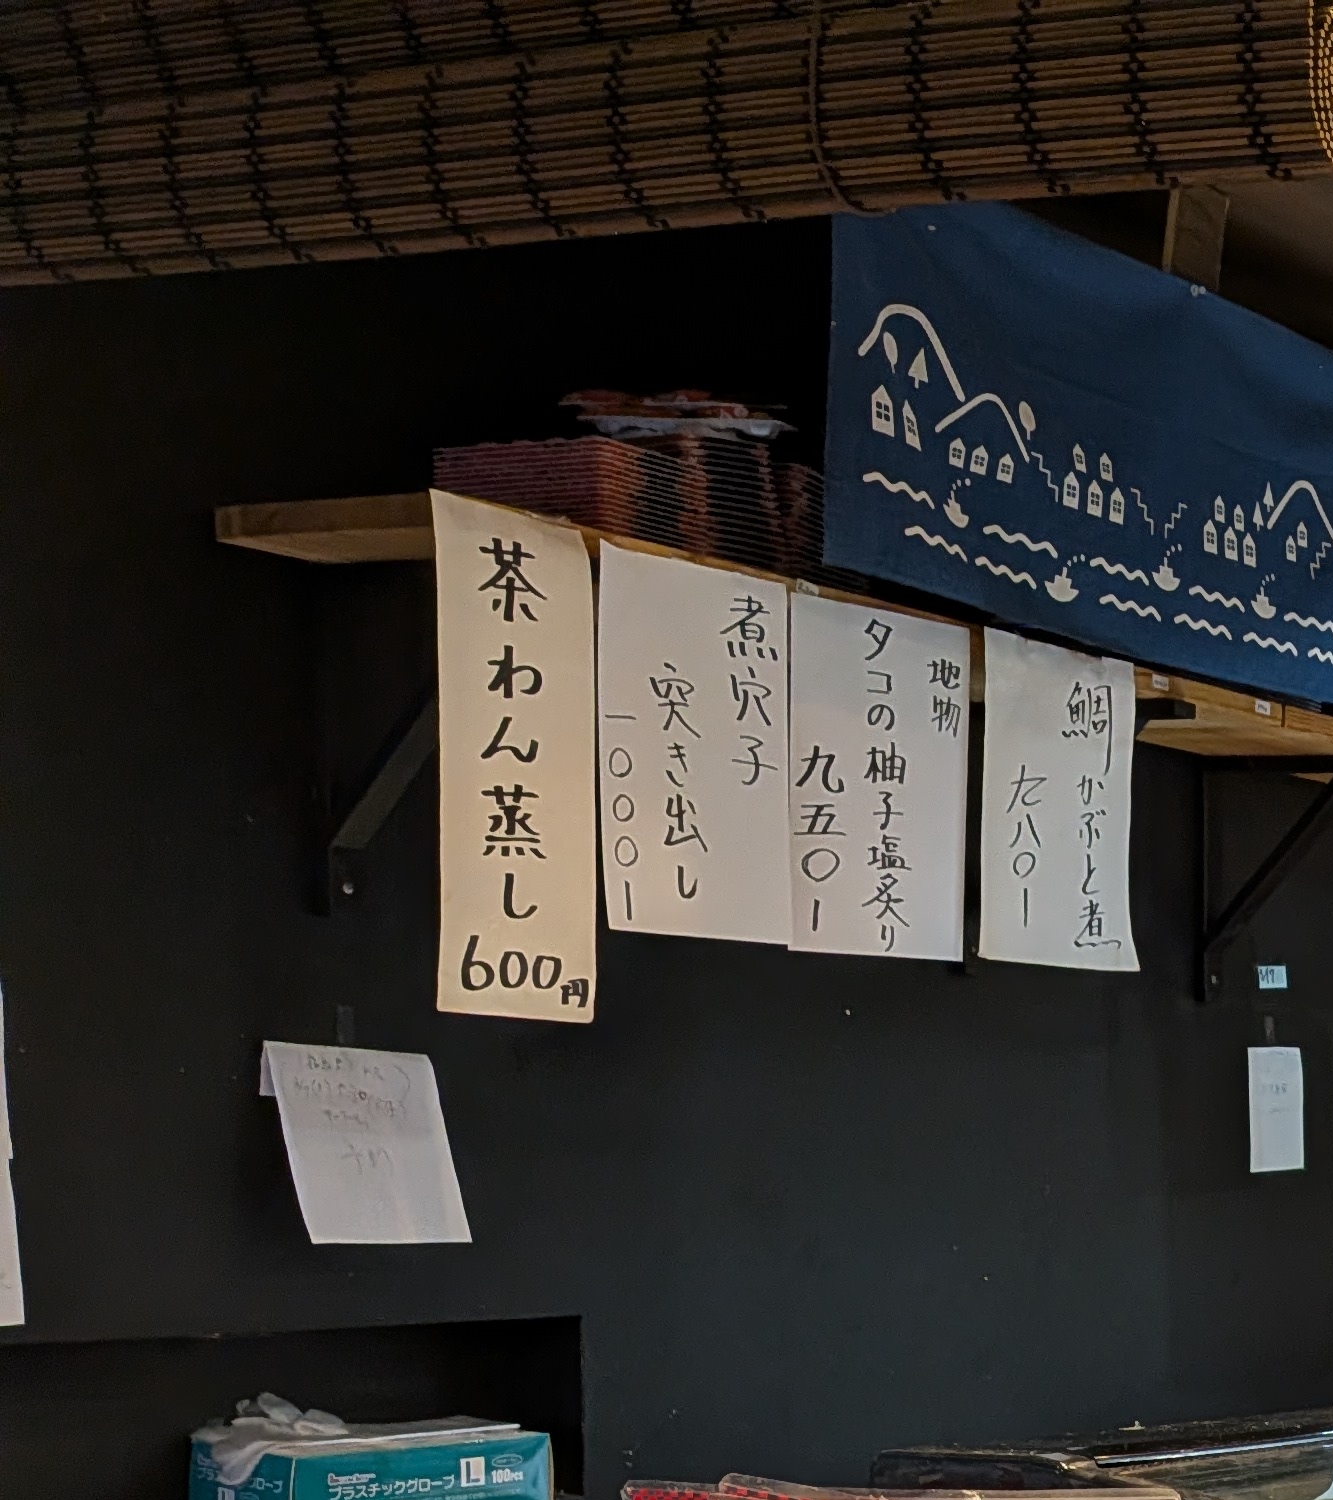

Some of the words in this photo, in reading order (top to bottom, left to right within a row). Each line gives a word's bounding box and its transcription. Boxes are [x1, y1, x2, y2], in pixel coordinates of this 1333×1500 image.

[479, 537, 548, 920] 茶わん蒸し
[649, 662, 708, 899] 突き出し
[719, 596, 779, 786] 煮穴子
[927, 659, 962, 738] 地物
[1061, 682, 1122, 950] 鯛かぶと煮
[460, 935, 590, 1008] 600円
[463, 1460, 484, 1486] L
